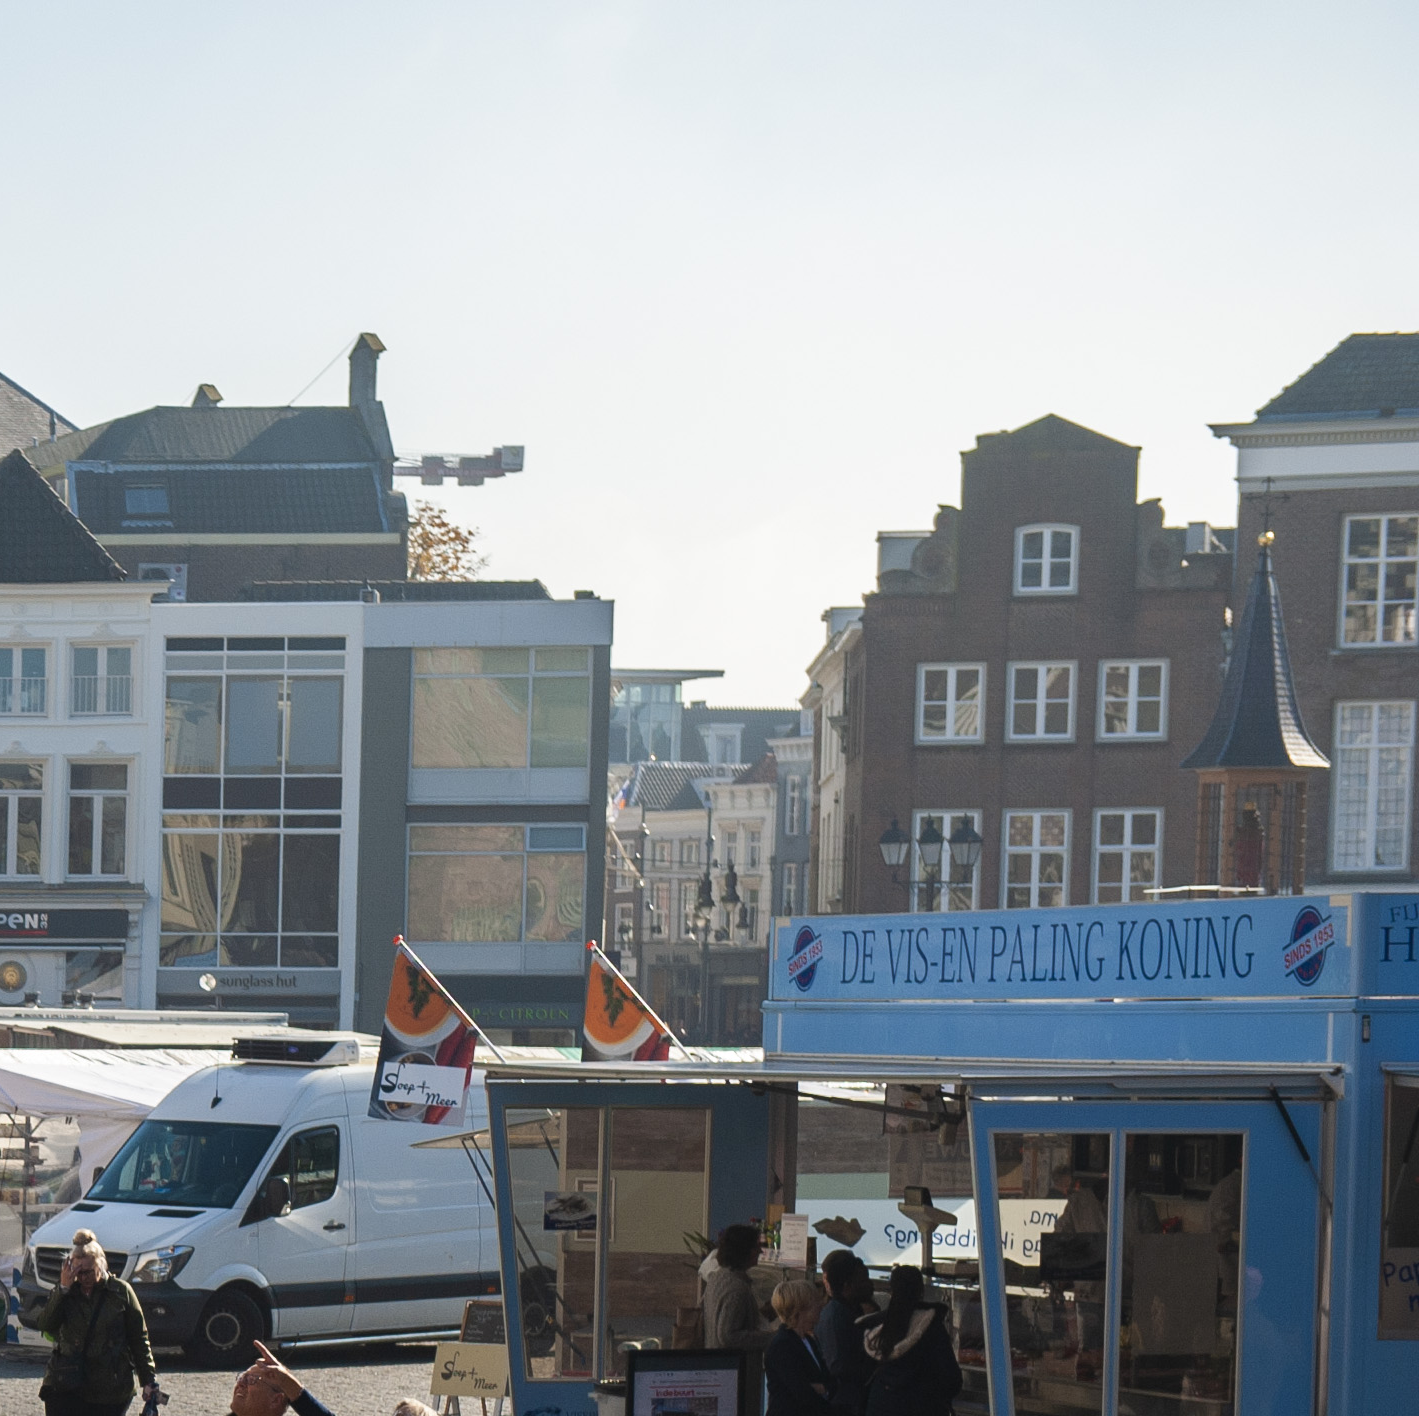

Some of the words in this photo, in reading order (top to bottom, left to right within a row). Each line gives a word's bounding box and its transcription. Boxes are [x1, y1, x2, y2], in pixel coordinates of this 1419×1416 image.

[788, 952, 808, 977] SINDS
[808, 939, 823, 962] 1953
[840, 929, 876, 984] DE
[886, 926, 979, 985] VIS-EN
[988, 921, 1105, 982] PALING
[1116, 914, 1255, 981] KONING
[1284, 932, 1312, 971] SINDS
[1312, 922, 1335, 951] 1953
[220, 974, 274, 990] sunglass
[276, 974, 297, 987] hut
[380, 1063, 415, 1095] Soep
[425, 1092, 457, 1106] Meer
[441, 1351, 467, 1381] Soep
[474, 1378, 498, 1390] Meer
